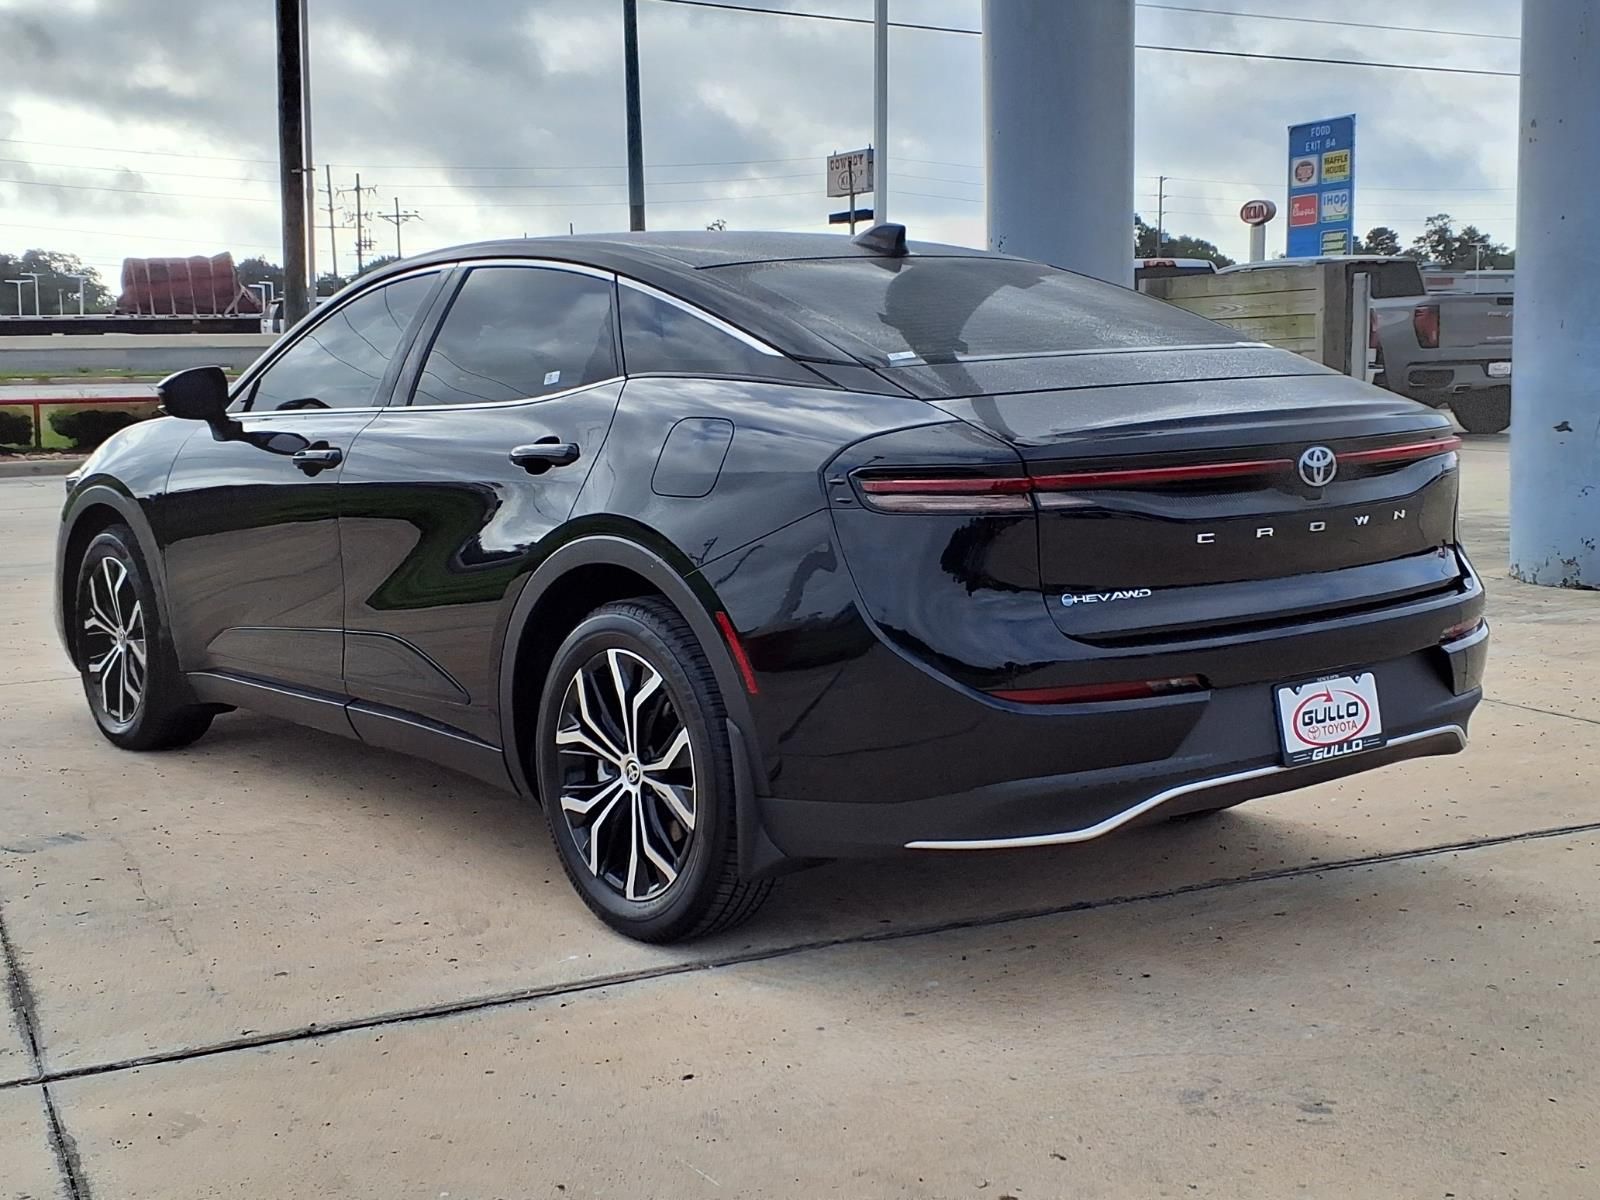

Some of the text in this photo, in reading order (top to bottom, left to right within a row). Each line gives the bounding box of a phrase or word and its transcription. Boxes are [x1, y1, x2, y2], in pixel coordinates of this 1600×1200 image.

[1311, 125, 1331, 137] FOOD
[1305, 140, 1321, 152] EXIT
[1244, 204, 1265, 220] KIA
[1197, 509, 1406, 544] CROWN
[1302, 701, 1359, 727] GULLO
[1322, 720, 1358, 736] TOYOTA
[1312, 739, 1363, 761] GULLO
